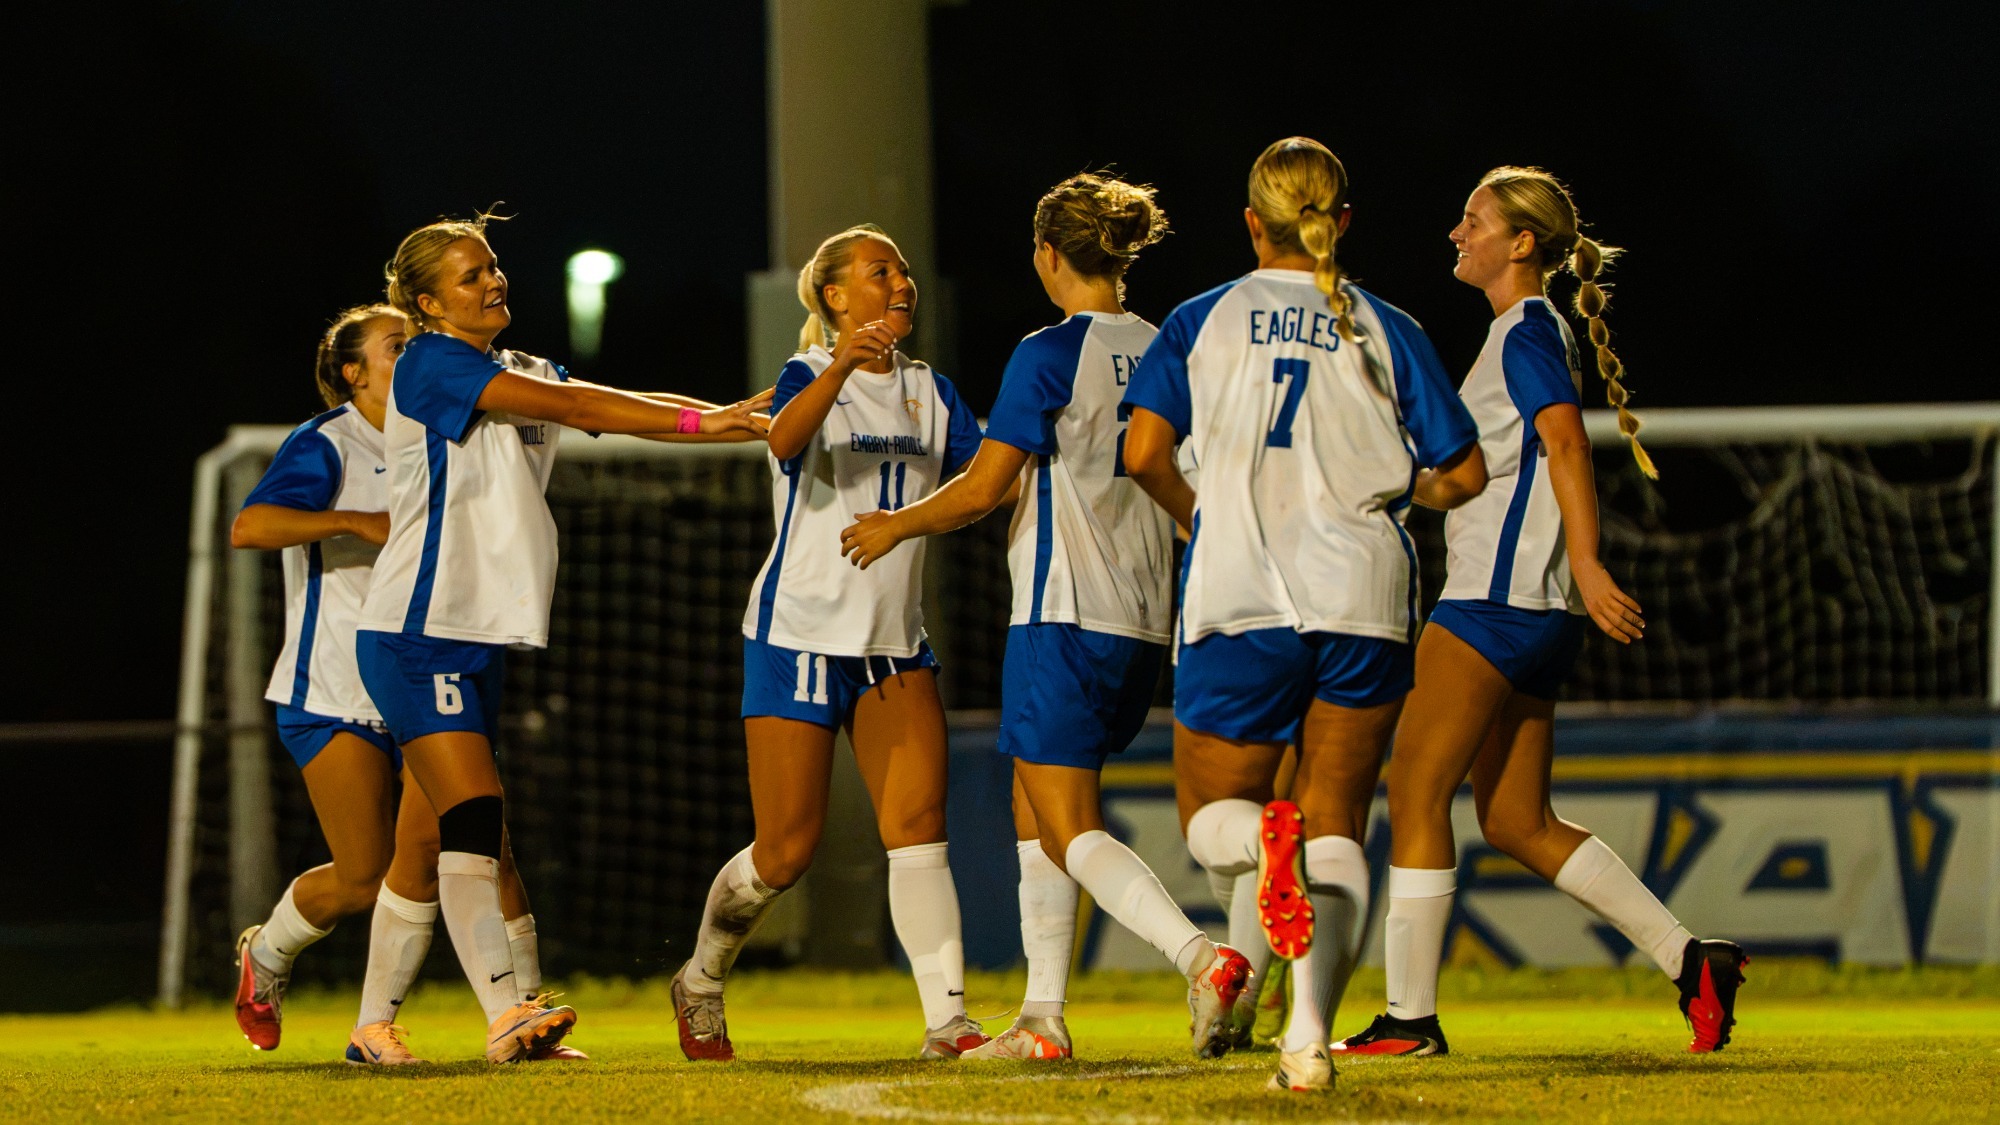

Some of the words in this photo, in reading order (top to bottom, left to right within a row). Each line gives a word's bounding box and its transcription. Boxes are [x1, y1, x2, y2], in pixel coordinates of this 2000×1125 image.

[1251, 307, 1340, 352] EAGLES
[1265, 357, 1311, 449] 7
[850, 432, 928, 456] EMBRY-RIDDLE
[878, 461, 906, 512] 11
[433, 672, 464, 716] 6
[794, 652, 829, 705] 11
